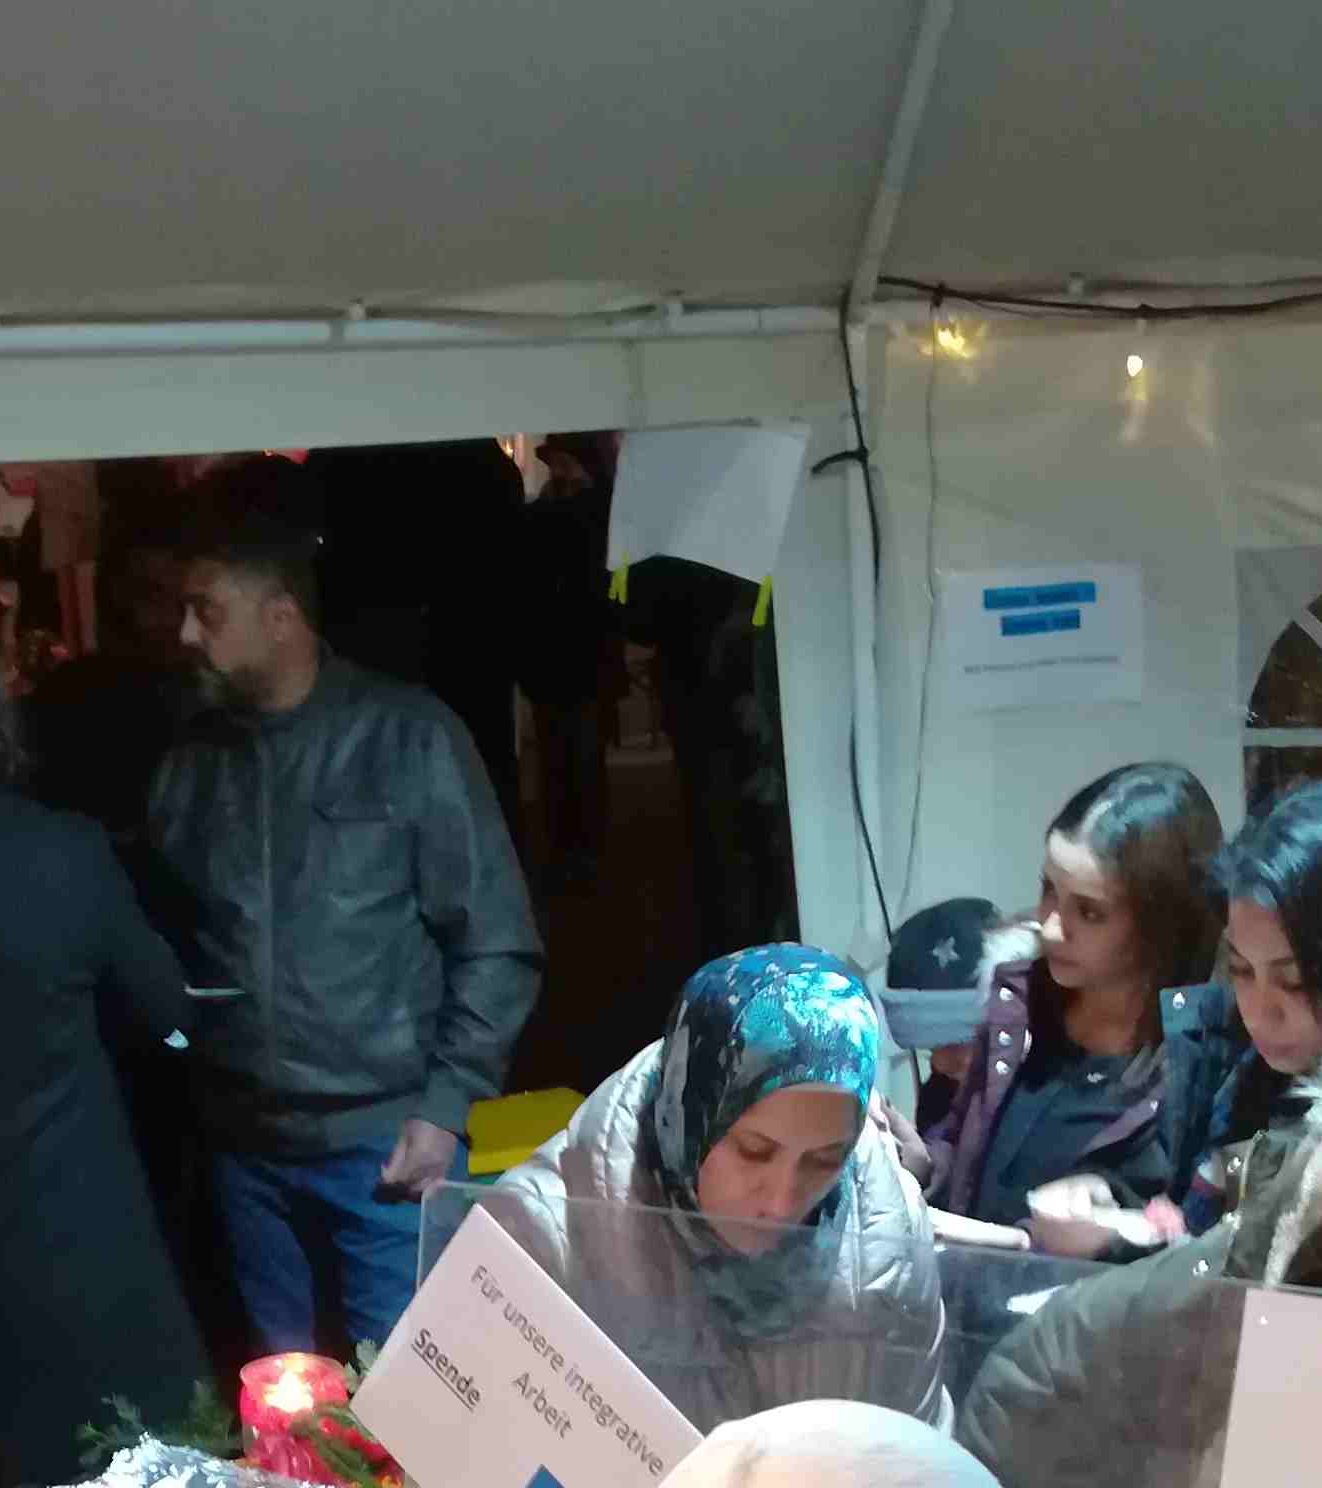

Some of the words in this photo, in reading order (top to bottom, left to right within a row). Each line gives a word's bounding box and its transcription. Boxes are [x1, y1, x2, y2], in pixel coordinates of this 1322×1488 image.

[413, 1328, 482, 1408] Spende
[471, 1265, 504, 1303] Für
[503, 1303, 565, 1372] unsere
[564, 1364, 664, 1477] integrative
[513, 1372, 573, 1439] Arbeit
